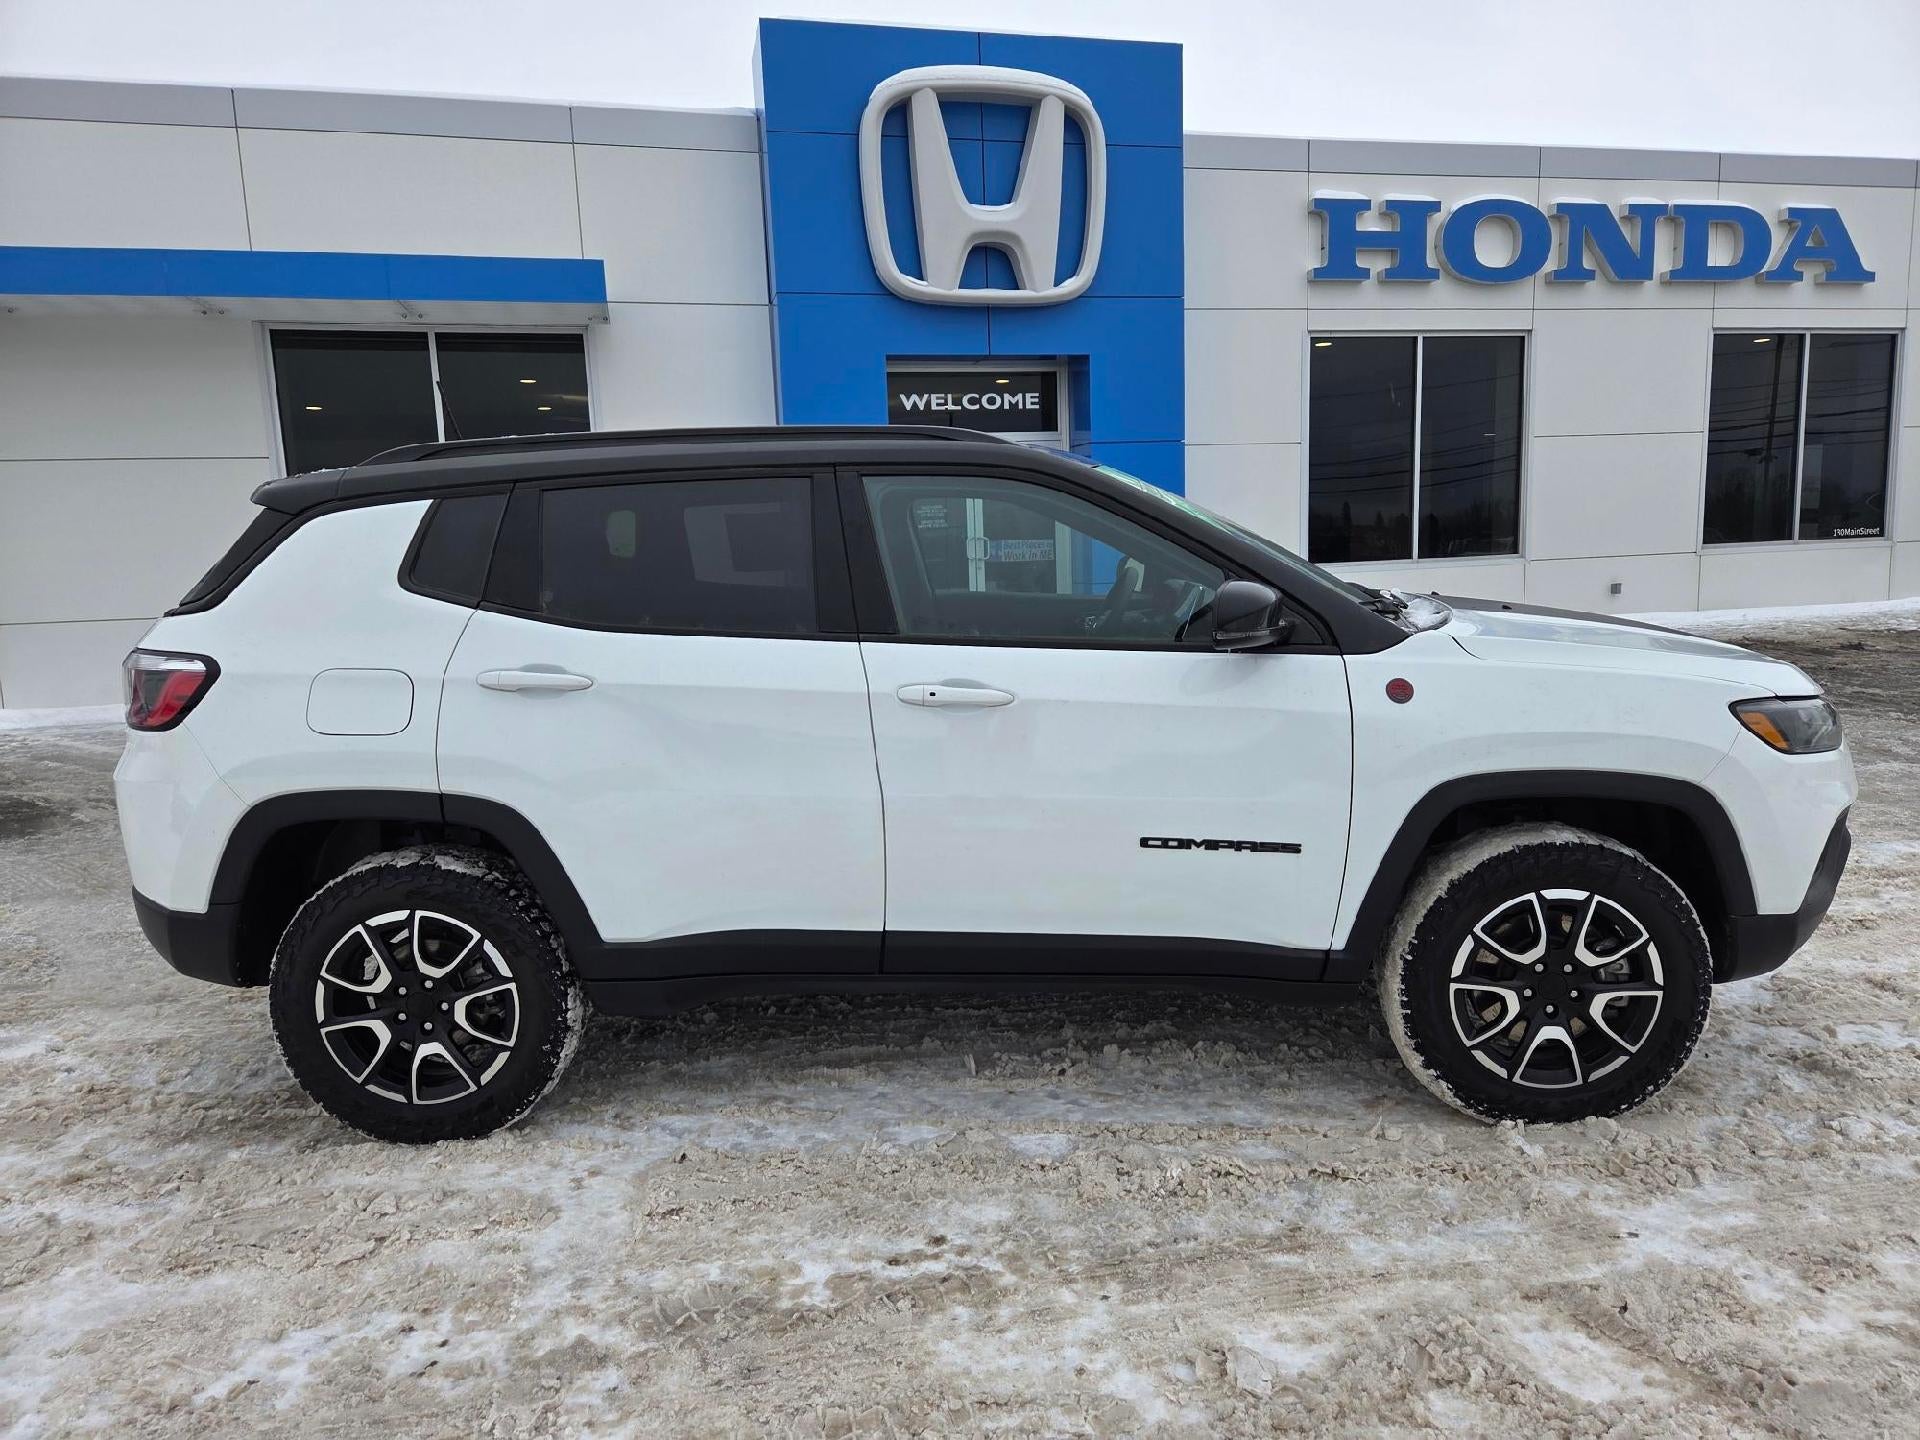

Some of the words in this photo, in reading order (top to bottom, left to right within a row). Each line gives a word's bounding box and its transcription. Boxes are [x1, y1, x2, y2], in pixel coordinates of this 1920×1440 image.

[1308, 194, 1876, 284] HONDA
[899, 393, 1040, 411] WELCOME
[1004, 550, 1026, 561] Work
[1139, 836, 1302, 854] COMPASS
